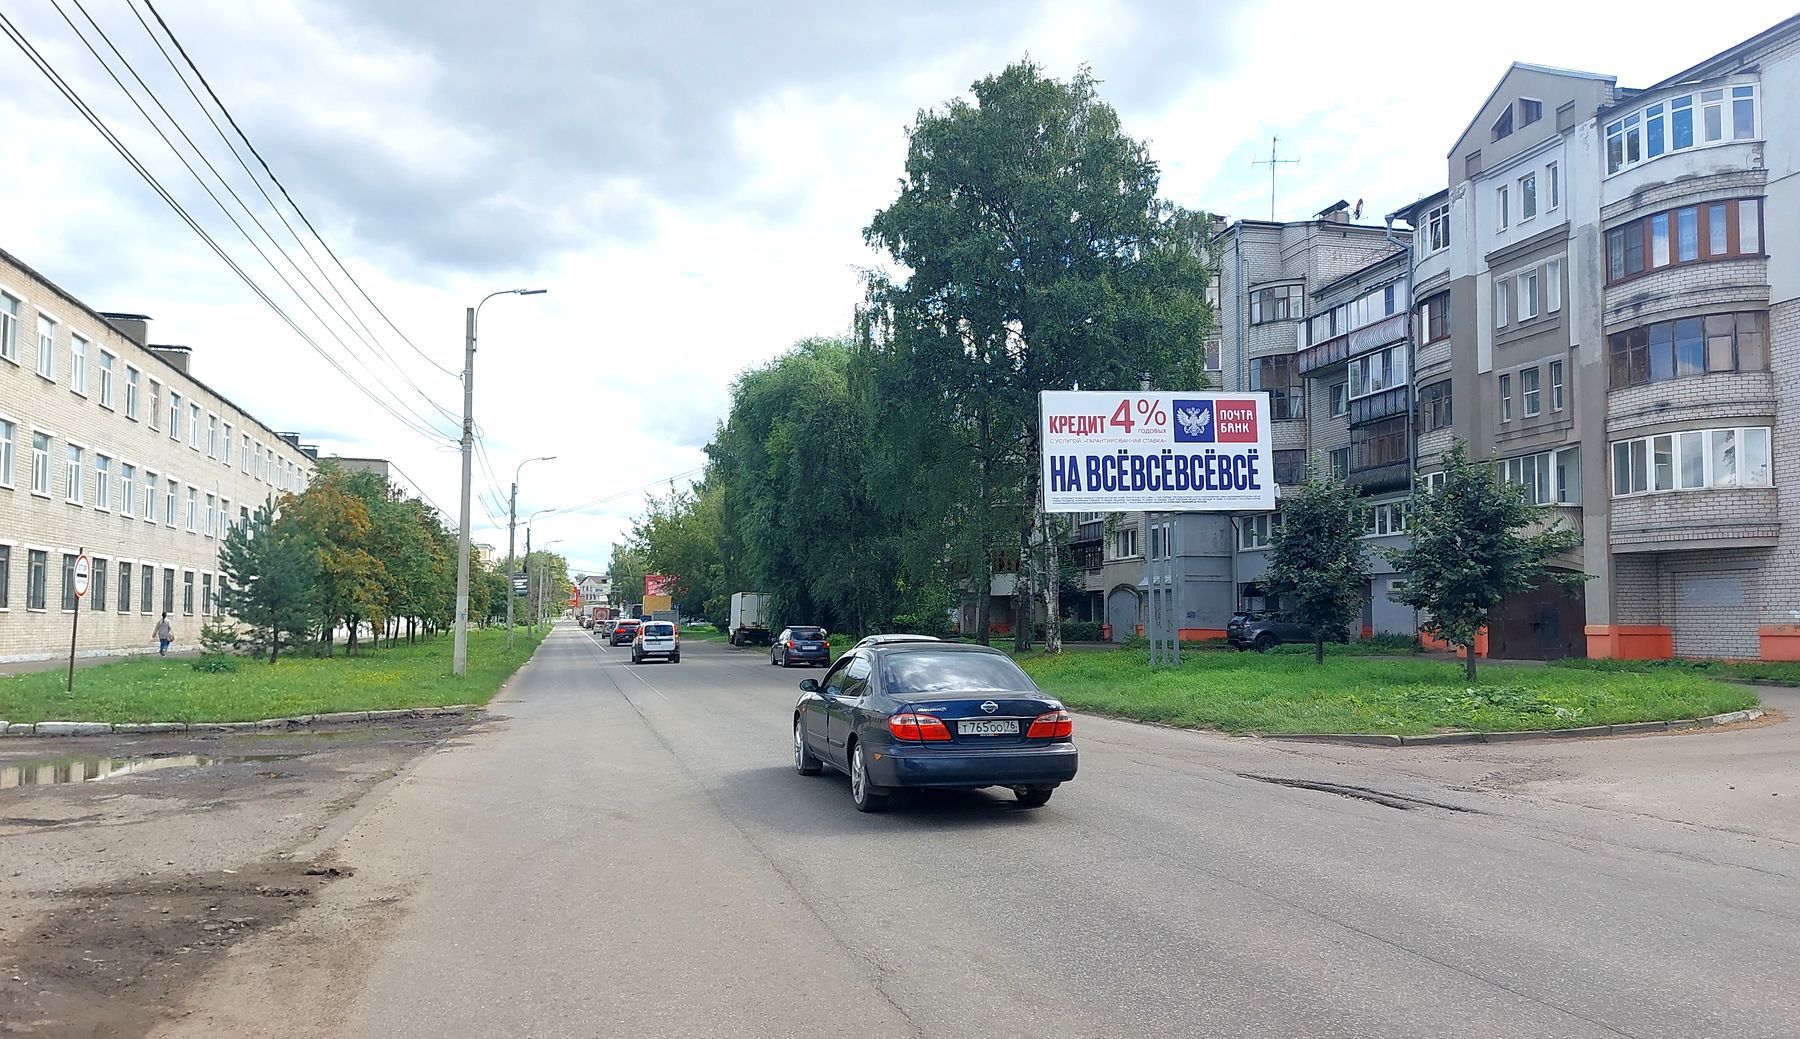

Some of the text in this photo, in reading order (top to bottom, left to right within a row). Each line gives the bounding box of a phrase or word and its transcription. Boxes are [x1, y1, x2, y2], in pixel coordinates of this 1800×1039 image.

[1049, 399, 1167, 436] КРЕДИТ 4%
[1220, 409, 1254, 421] ПОЧТА
[1220, 422, 1250, 434] БАНК
[1050, 448, 1261, 492] НА ВСЁВСЁВСЁВСЁ
